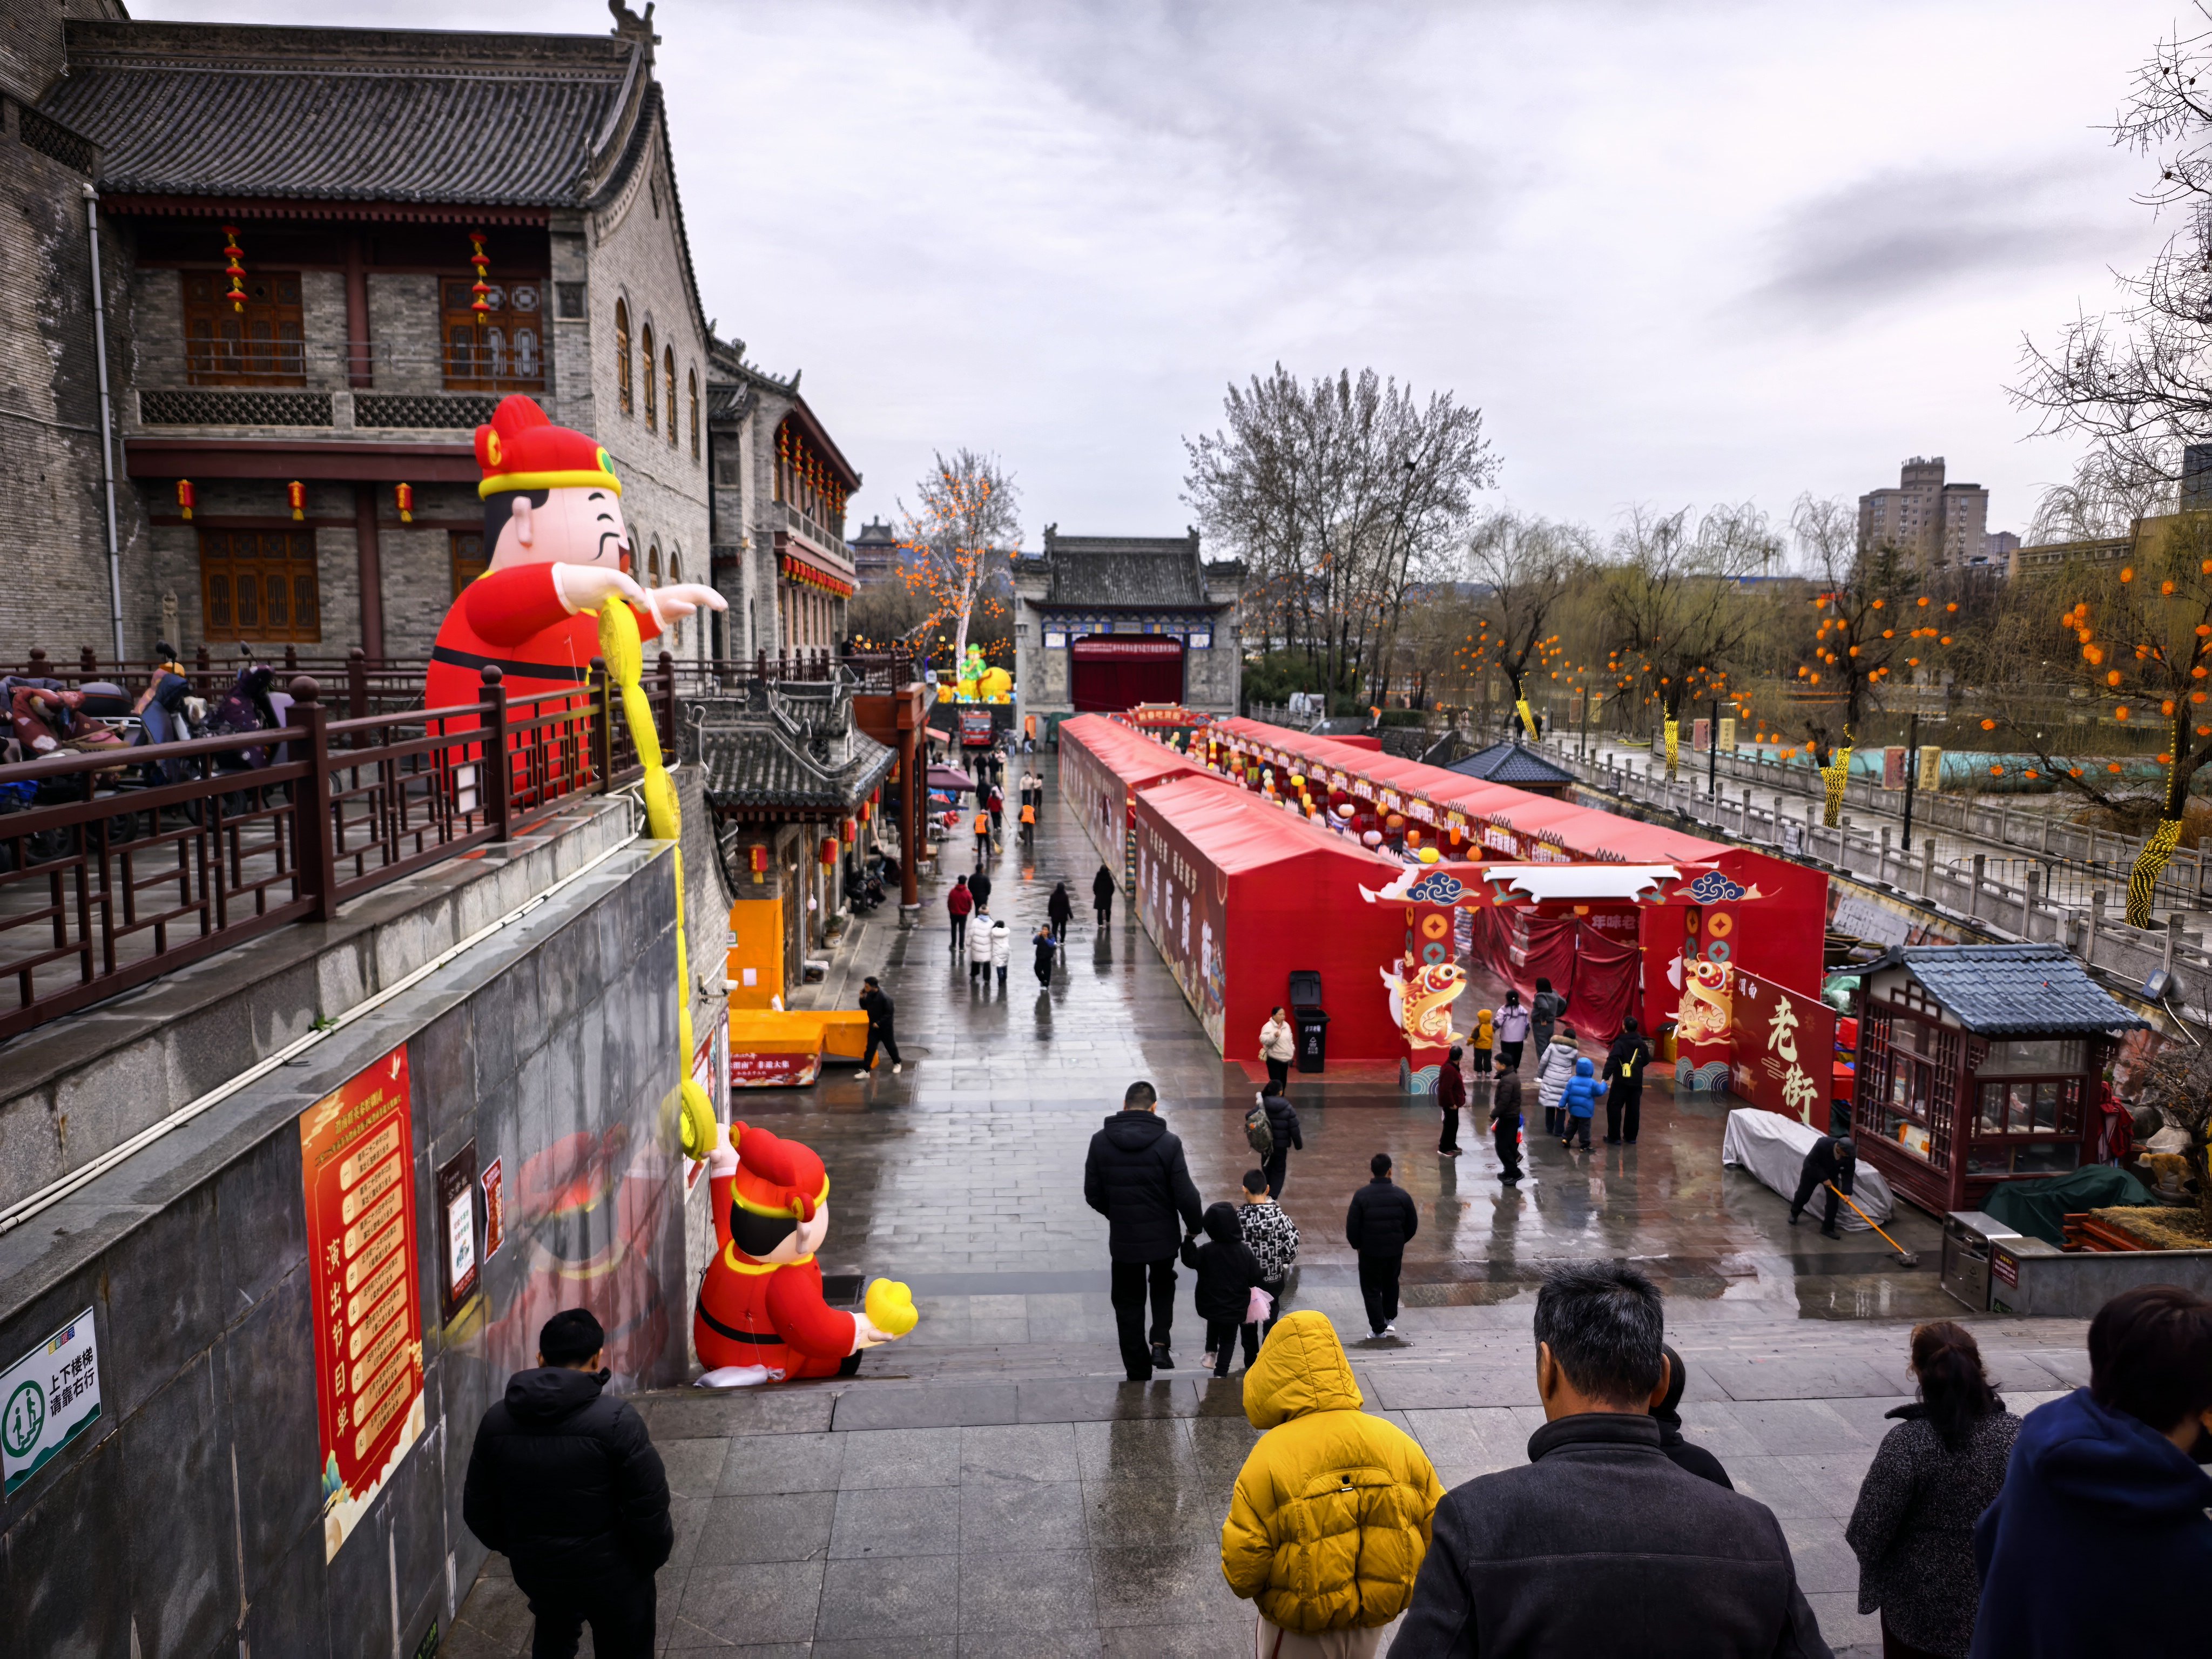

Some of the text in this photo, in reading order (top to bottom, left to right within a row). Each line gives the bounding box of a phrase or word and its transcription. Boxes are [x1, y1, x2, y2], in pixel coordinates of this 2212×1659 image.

[1591, 914, 1640, 930] 年味老
[1739, 977, 1757, 1000] 渭南
[1768, 995, 1818, 1124] 老街
[326, 1233, 349, 1445] 演出节目单
[49, 1346, 93, 1396] 上下楼梯
[50, 1367, 95, 1417] 请靠右行
